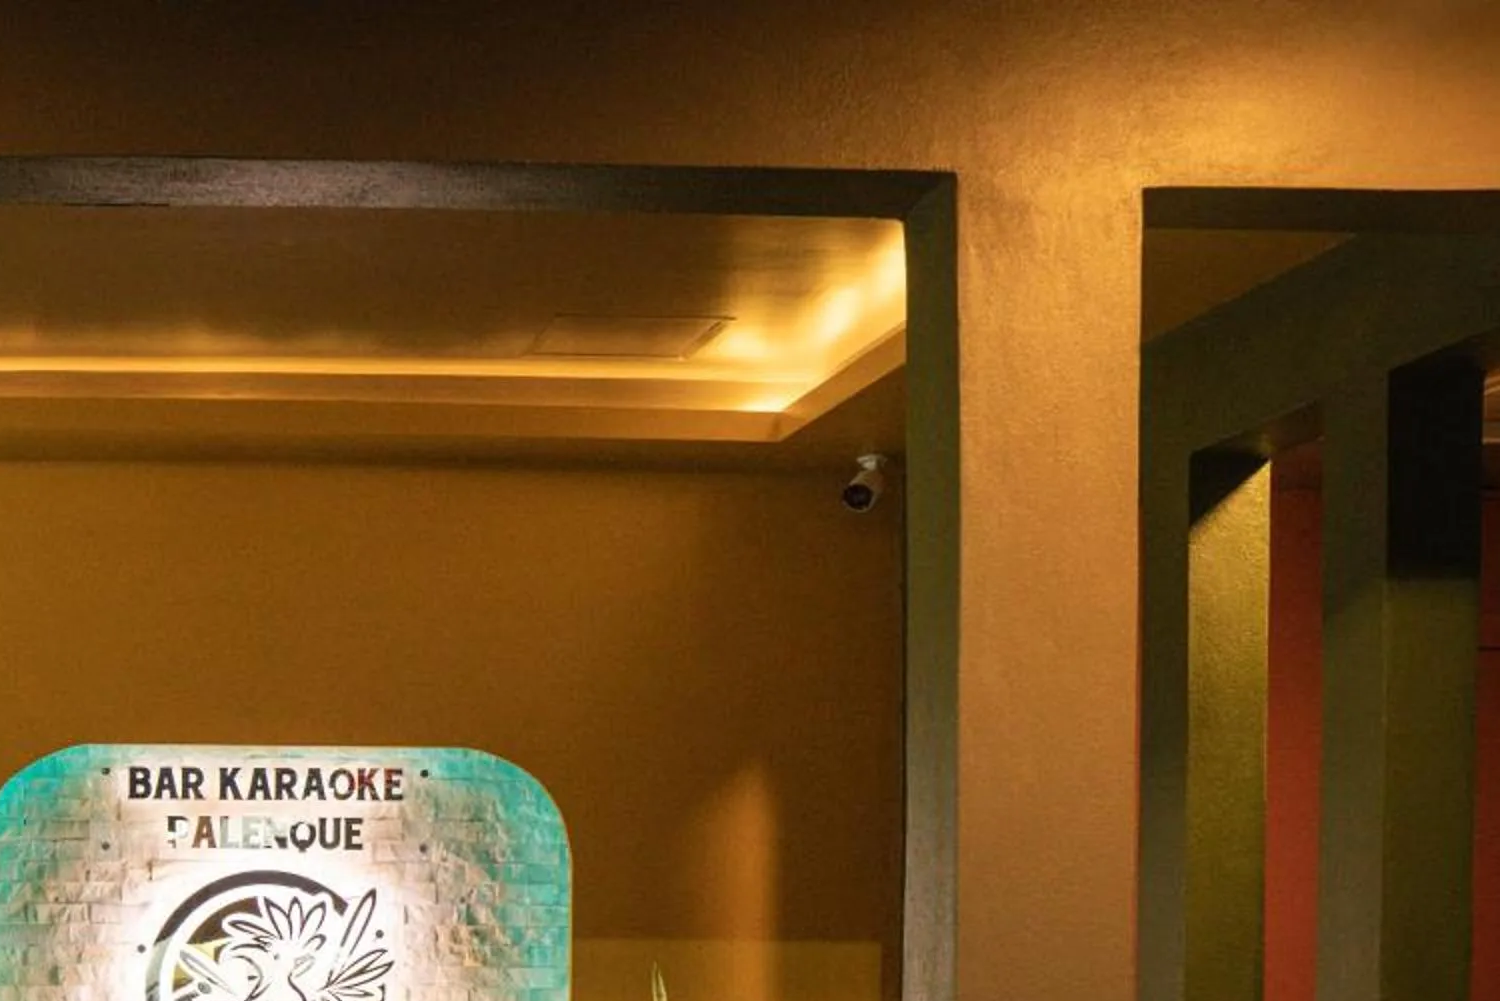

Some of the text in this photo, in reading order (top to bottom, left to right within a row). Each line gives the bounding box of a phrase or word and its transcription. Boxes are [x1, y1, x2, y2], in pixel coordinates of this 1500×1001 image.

[127, 766, 404, 801] BAR KARAOKE
[167, 815, 365, 853] PALENQUE
